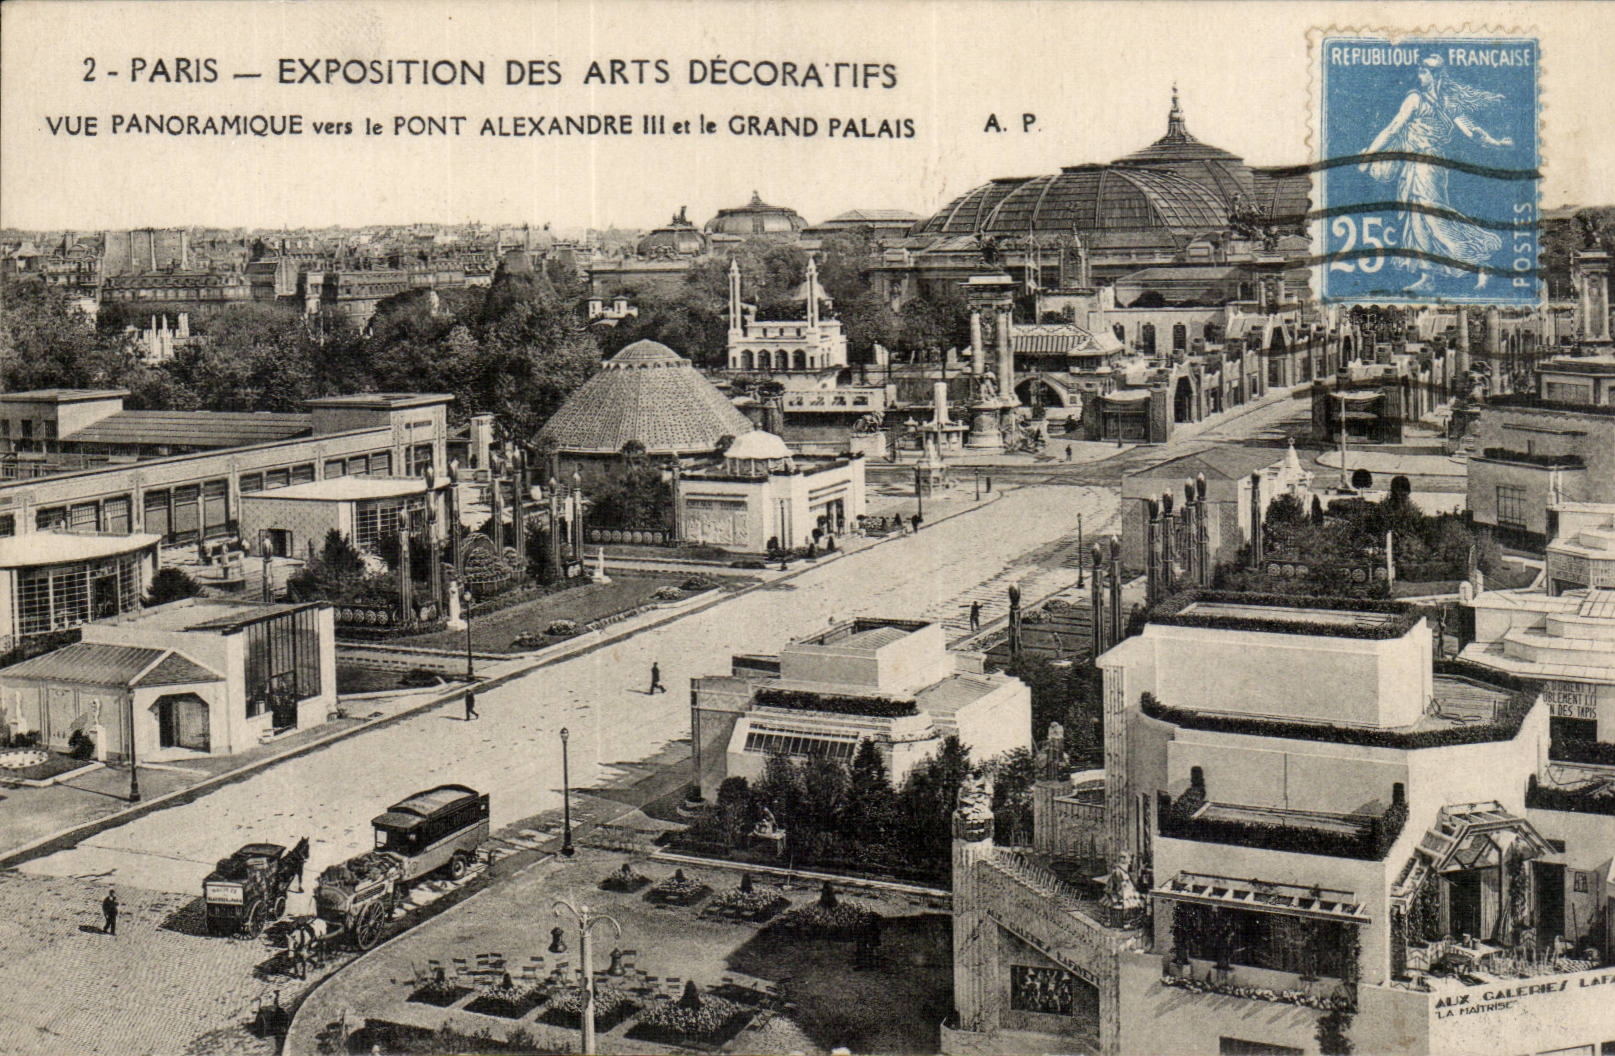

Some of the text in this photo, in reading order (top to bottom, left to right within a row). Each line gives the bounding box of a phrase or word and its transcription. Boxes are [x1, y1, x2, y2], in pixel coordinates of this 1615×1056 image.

[1448, 48, 1531, 68] FRANÇAISE
[1512, 202, 1532, 288] POSTES
[1558, 704, 1573, 717] DES
[1577, 706, 1597, 718] TAPIS
[1435, 994, 1470, 1009] AUX
[1482, 980, 1568, 1002] GALERIES
